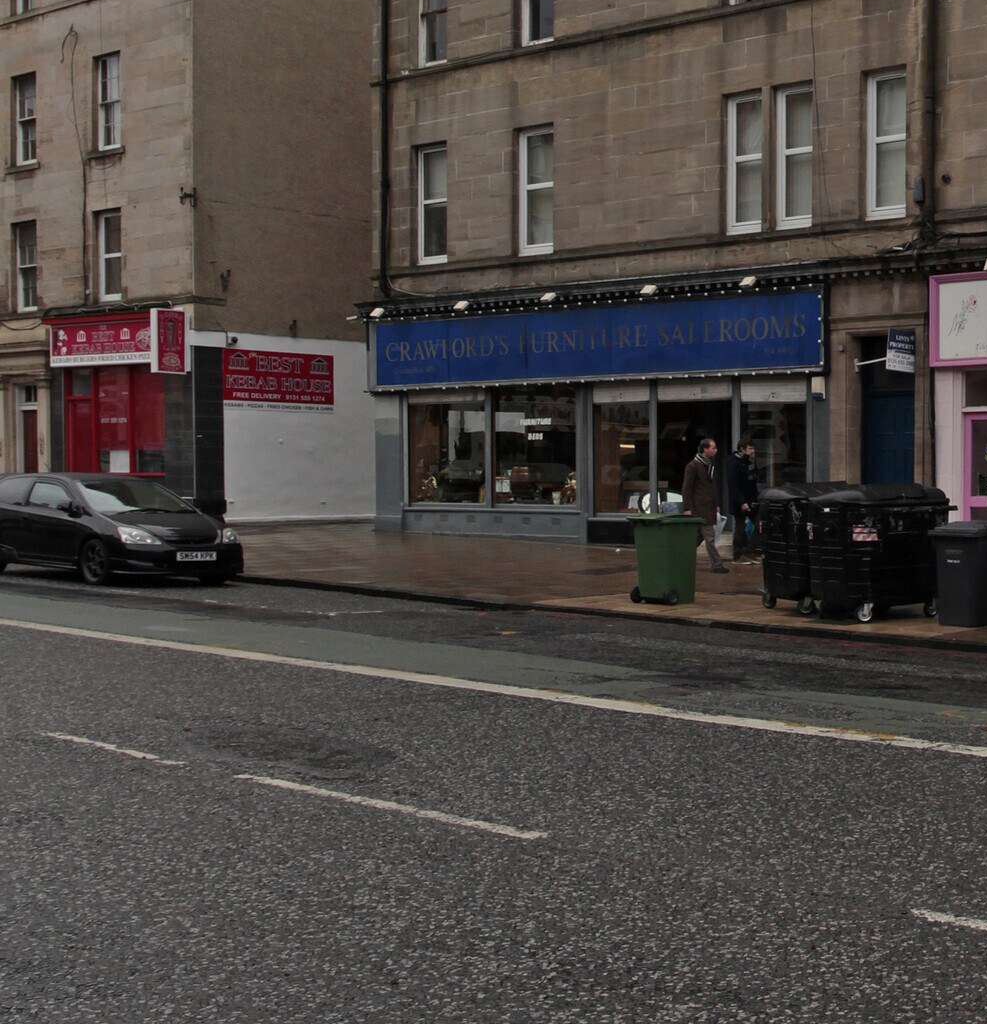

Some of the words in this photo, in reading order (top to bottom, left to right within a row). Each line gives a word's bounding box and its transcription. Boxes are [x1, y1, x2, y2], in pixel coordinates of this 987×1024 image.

[255, 355, 304, 374] BEST
[226, 374, 279, 391] KEBAB
[281, 377, 332, 393] HOUSE
[232, 391, 250, 399] FREE
[251, 392, 281, 400] DELIVERY
[520, 417, 552, 426] FURNITURE
[527, 432, 544, 441] BEDS
[179, 552, 198, 560] SM54
